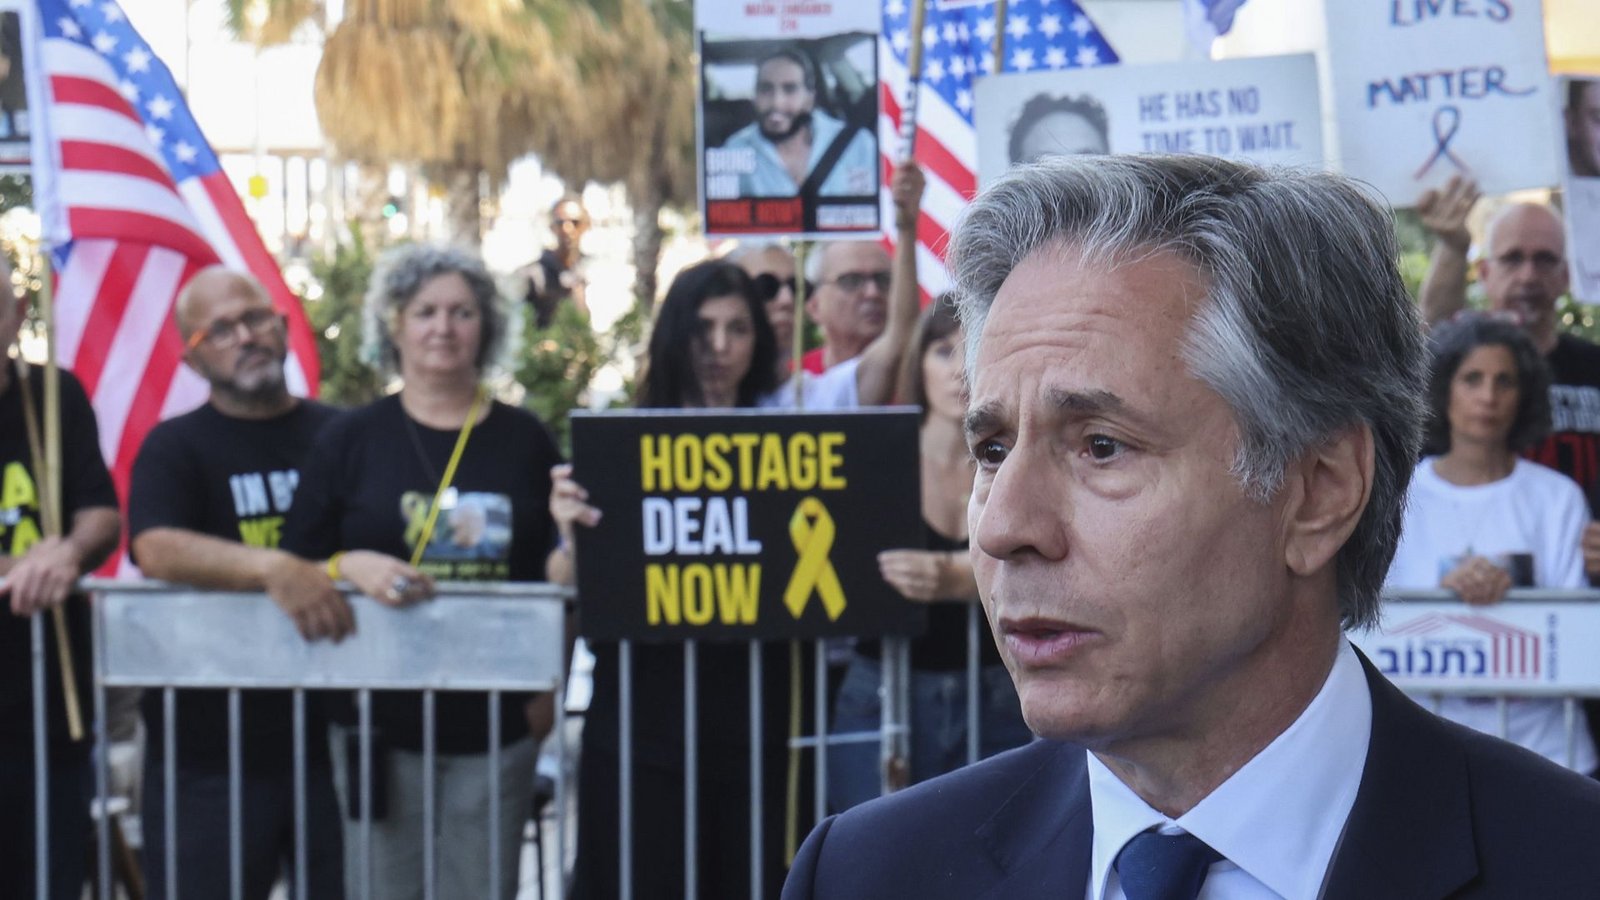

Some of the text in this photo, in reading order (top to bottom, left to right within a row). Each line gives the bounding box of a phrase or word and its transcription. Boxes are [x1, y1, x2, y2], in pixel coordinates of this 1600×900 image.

[1138, 86, 1260, 121] HE HAS NO
[1367, 66, 1538, 109] MATTER
[1142, 129, 1194, 153] TIME
[1203, 127, 1231, 154] TO
[640, 433, 847, 491] HOSTAGE
[228, 472, 270, 517] IN
[642, 497, 762, 555] DEAL
[645, 563, 761, 625] NOW
[1377, 641, 1487, 676] נתנוב
